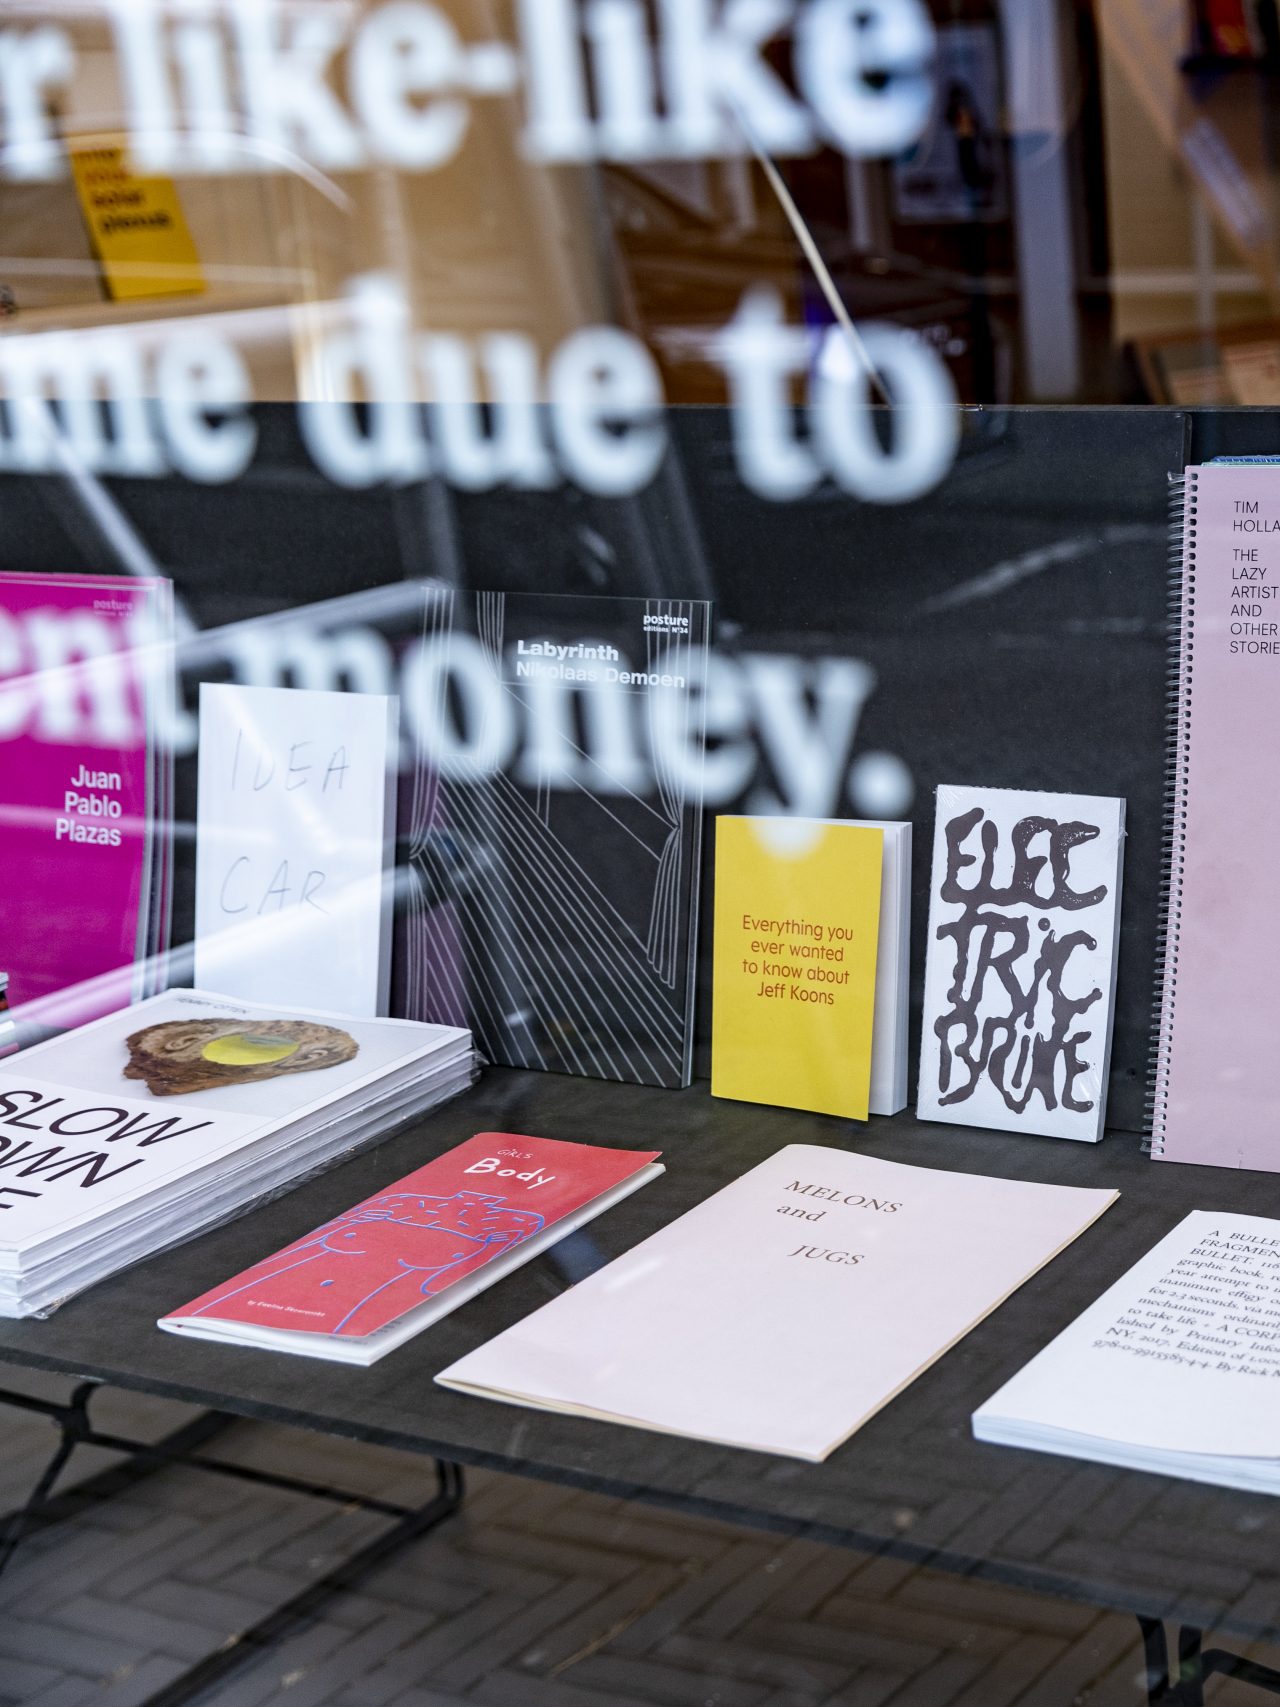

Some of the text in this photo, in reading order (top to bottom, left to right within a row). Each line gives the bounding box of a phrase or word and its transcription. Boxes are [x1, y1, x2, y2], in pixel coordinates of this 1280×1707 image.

[297, 270, 665, 496] due
[730, 285, 960, 503] to
[1233, 500, 1259, 514] TIM
[1232, 548, 1259, 562] THE
[1231, 567, 1267, 581] LAZY
[1230, 585, 1280, 599] ARTIST
[643, 614, 689, 627] posture
[1230, 604, 1263, 618] AND
[1230, 622, 1278, 636] OTHER
[517, 639, 620, 662] Labyrinth
[516, 661, 686, 689] Nikolaas Demoen
[232, 728, 351, 793] IDEA
[70, 764, 122, 791] Juan
[64, 790, 122, 819] Pablo
[55, 817, 122, 847] Plazas
[219, 855, 331, 916] CAR
[742, 914, 854, 943] Everything you
[751, 940, 844, 962] ever wanted
[742, 959, 851, 985] to know about
[757, 981, 835, 1005] Jeff Koons
[0, 1090, 215, 1147] SLOW
[463, 1157, 556, 1190] Body
[784, 1180, 903, 1213] MELONS
[776, 1205, 827, 1222] and
[788, 1245, 865, 1265] JUGS
[1216, 1324, 1228, 1332] A
